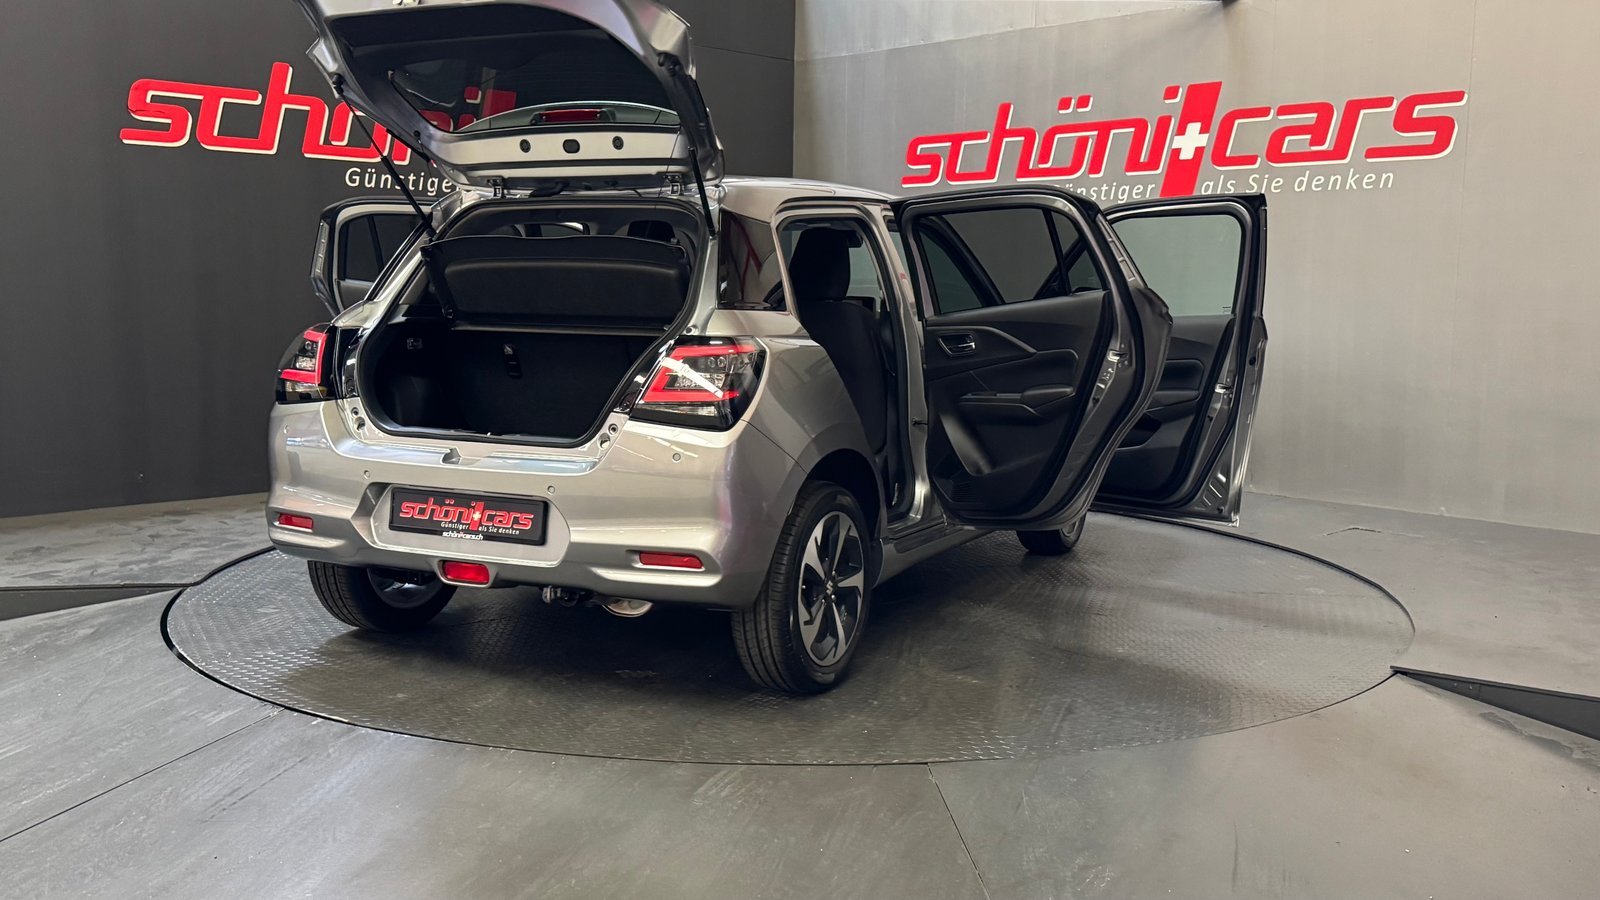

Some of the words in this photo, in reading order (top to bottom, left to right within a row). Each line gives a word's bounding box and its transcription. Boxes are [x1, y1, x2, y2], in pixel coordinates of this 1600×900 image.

[345, 167, 460, 196] Güntige
[1054, 182, 1155, 204] nstiger
[1201, 175, 1236, 195] als
[1246, 174, 1284, 193] Sie
[1294, 168, 1394, 192] denken
[441, 521, 469, 530] Günstiger
